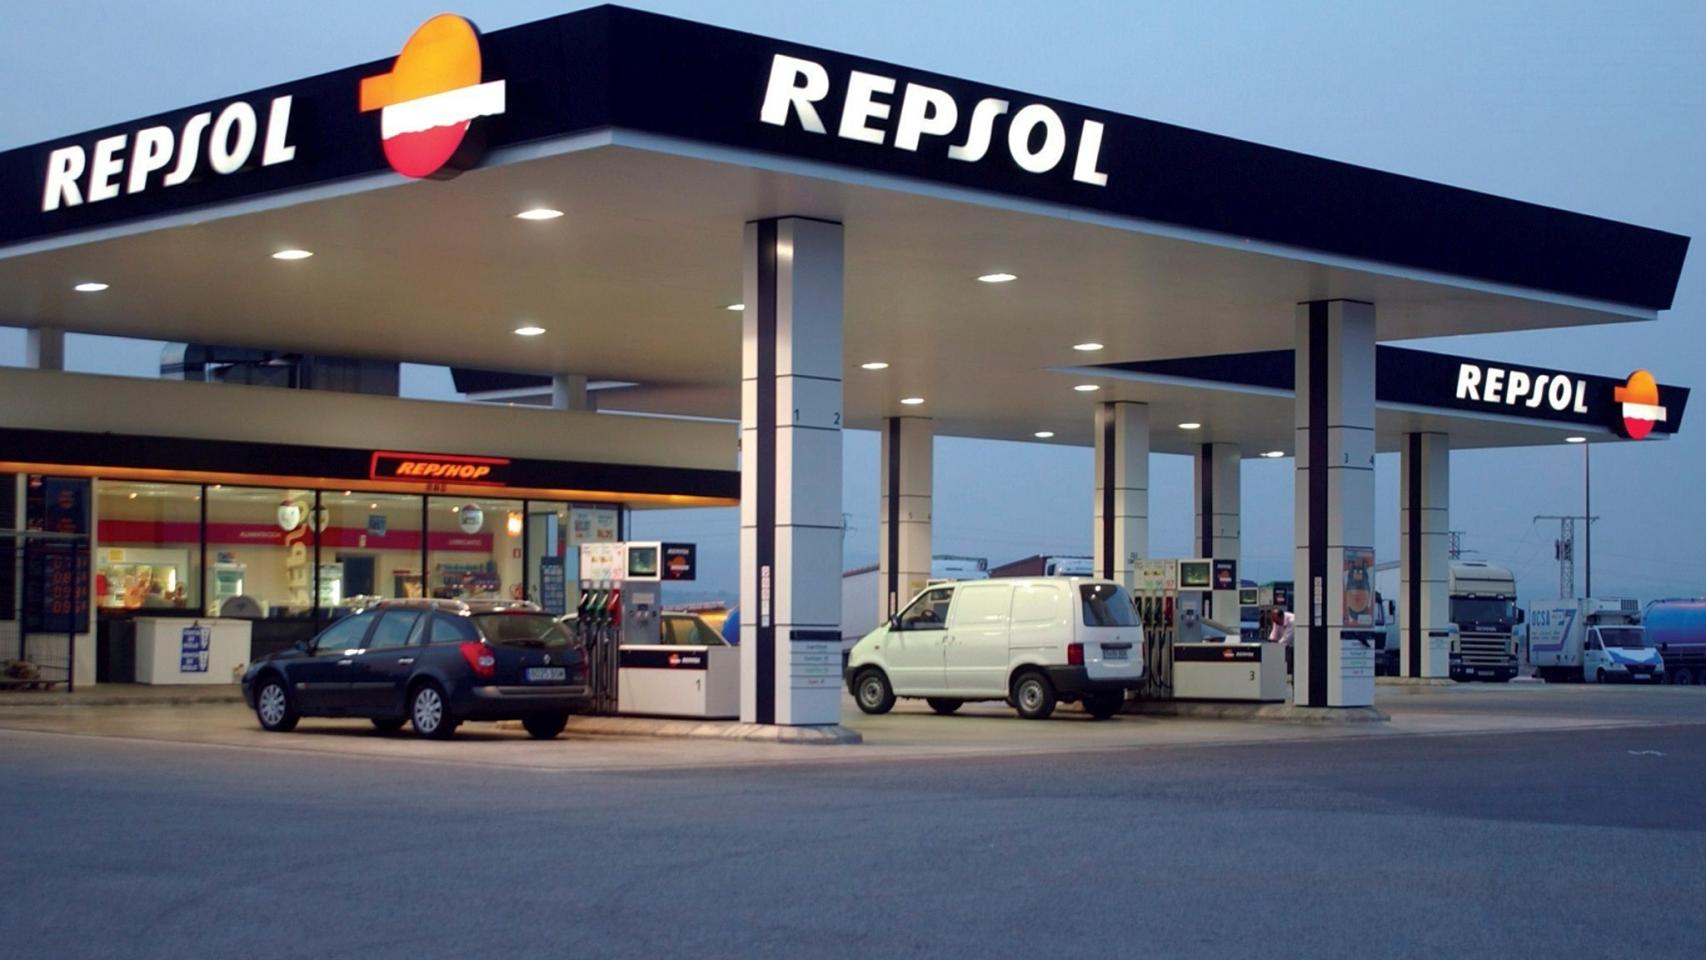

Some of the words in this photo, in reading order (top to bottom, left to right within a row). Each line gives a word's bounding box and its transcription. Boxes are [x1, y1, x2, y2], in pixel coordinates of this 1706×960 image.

[760, 53, 1109, 187] REPSOL
[41, 94, 296, 212] REPSOL
[1455, 363, 1589, 415] REPSOL
[793, 408, 800, 422] 1
[834, 411, 841, 425] 2
[396, 461, 491, 479] REPSHOP
[1531, 609, 1551, 626] OCSA
[695, 678, 702, 691] 1
[1249, 670, 1256, 682] 3
